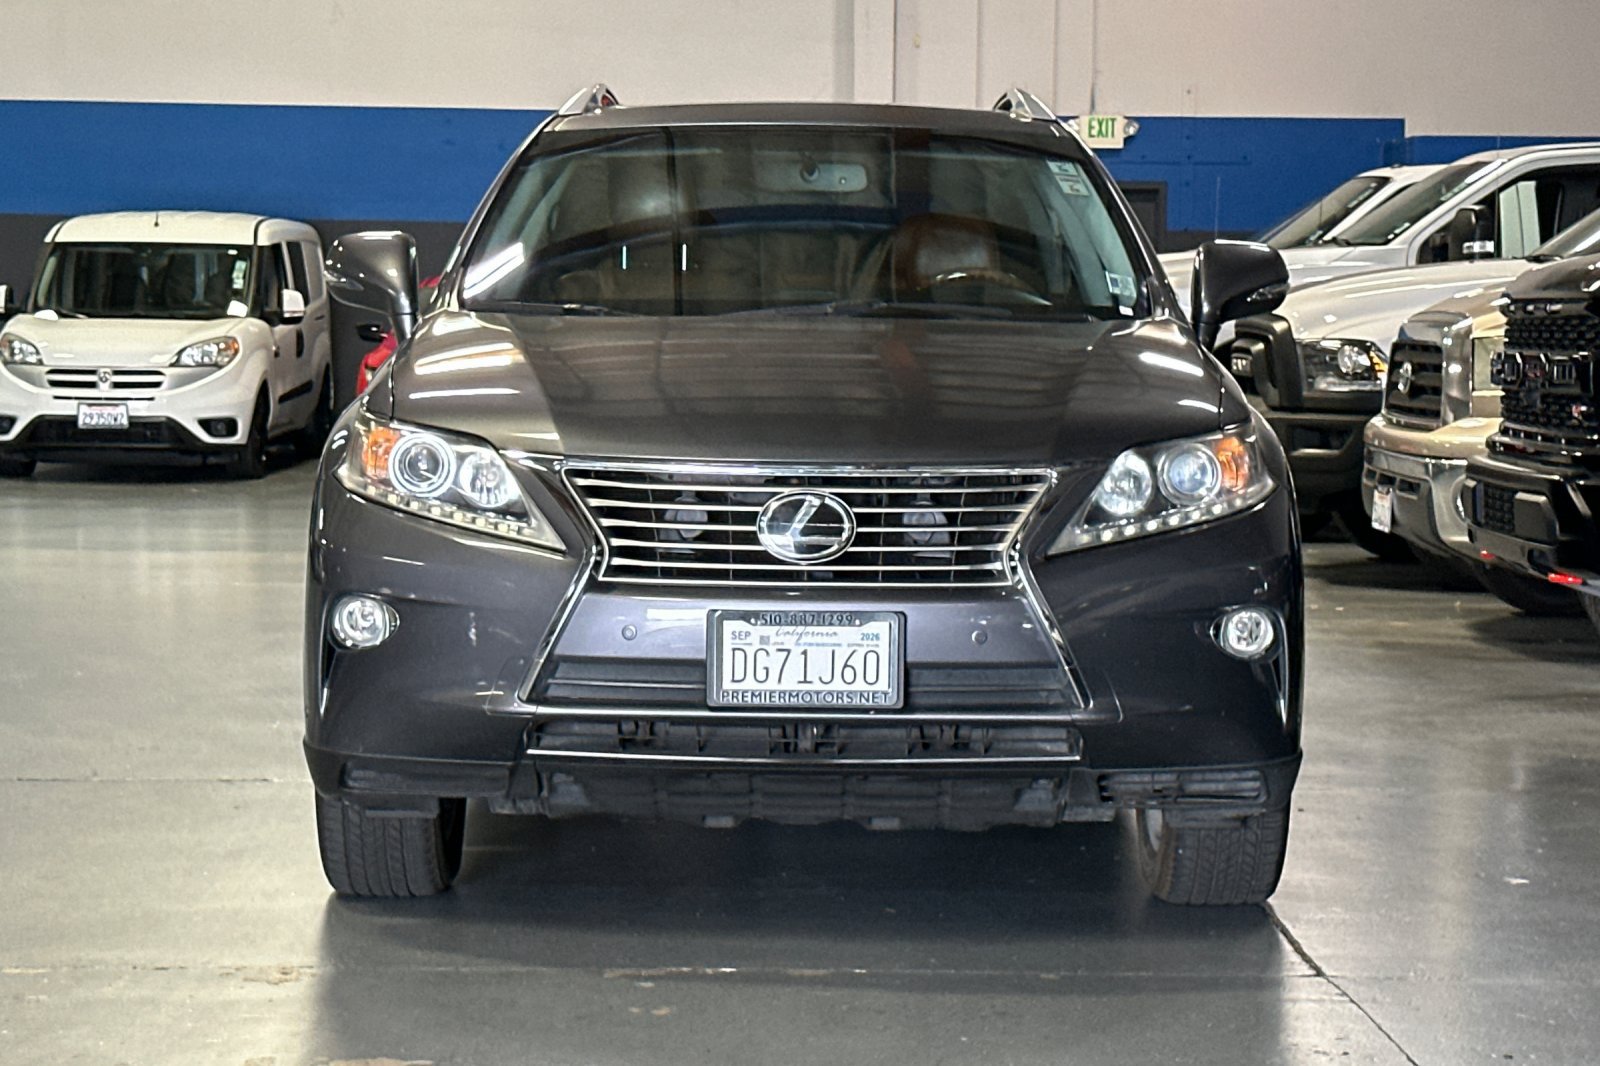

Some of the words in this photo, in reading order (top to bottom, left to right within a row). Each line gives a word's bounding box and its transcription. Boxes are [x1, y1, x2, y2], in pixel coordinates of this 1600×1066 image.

[1087, 117, 1117, 138] EXIT
[731, 630, 751, 640] SEP
[775, 625, 838, 644] California
[860, 632, 880, 641] 2026
[730, 647, 880, 686] DG71J60
[721, 690, 890, 705] PREMIERMOTORS.NET
